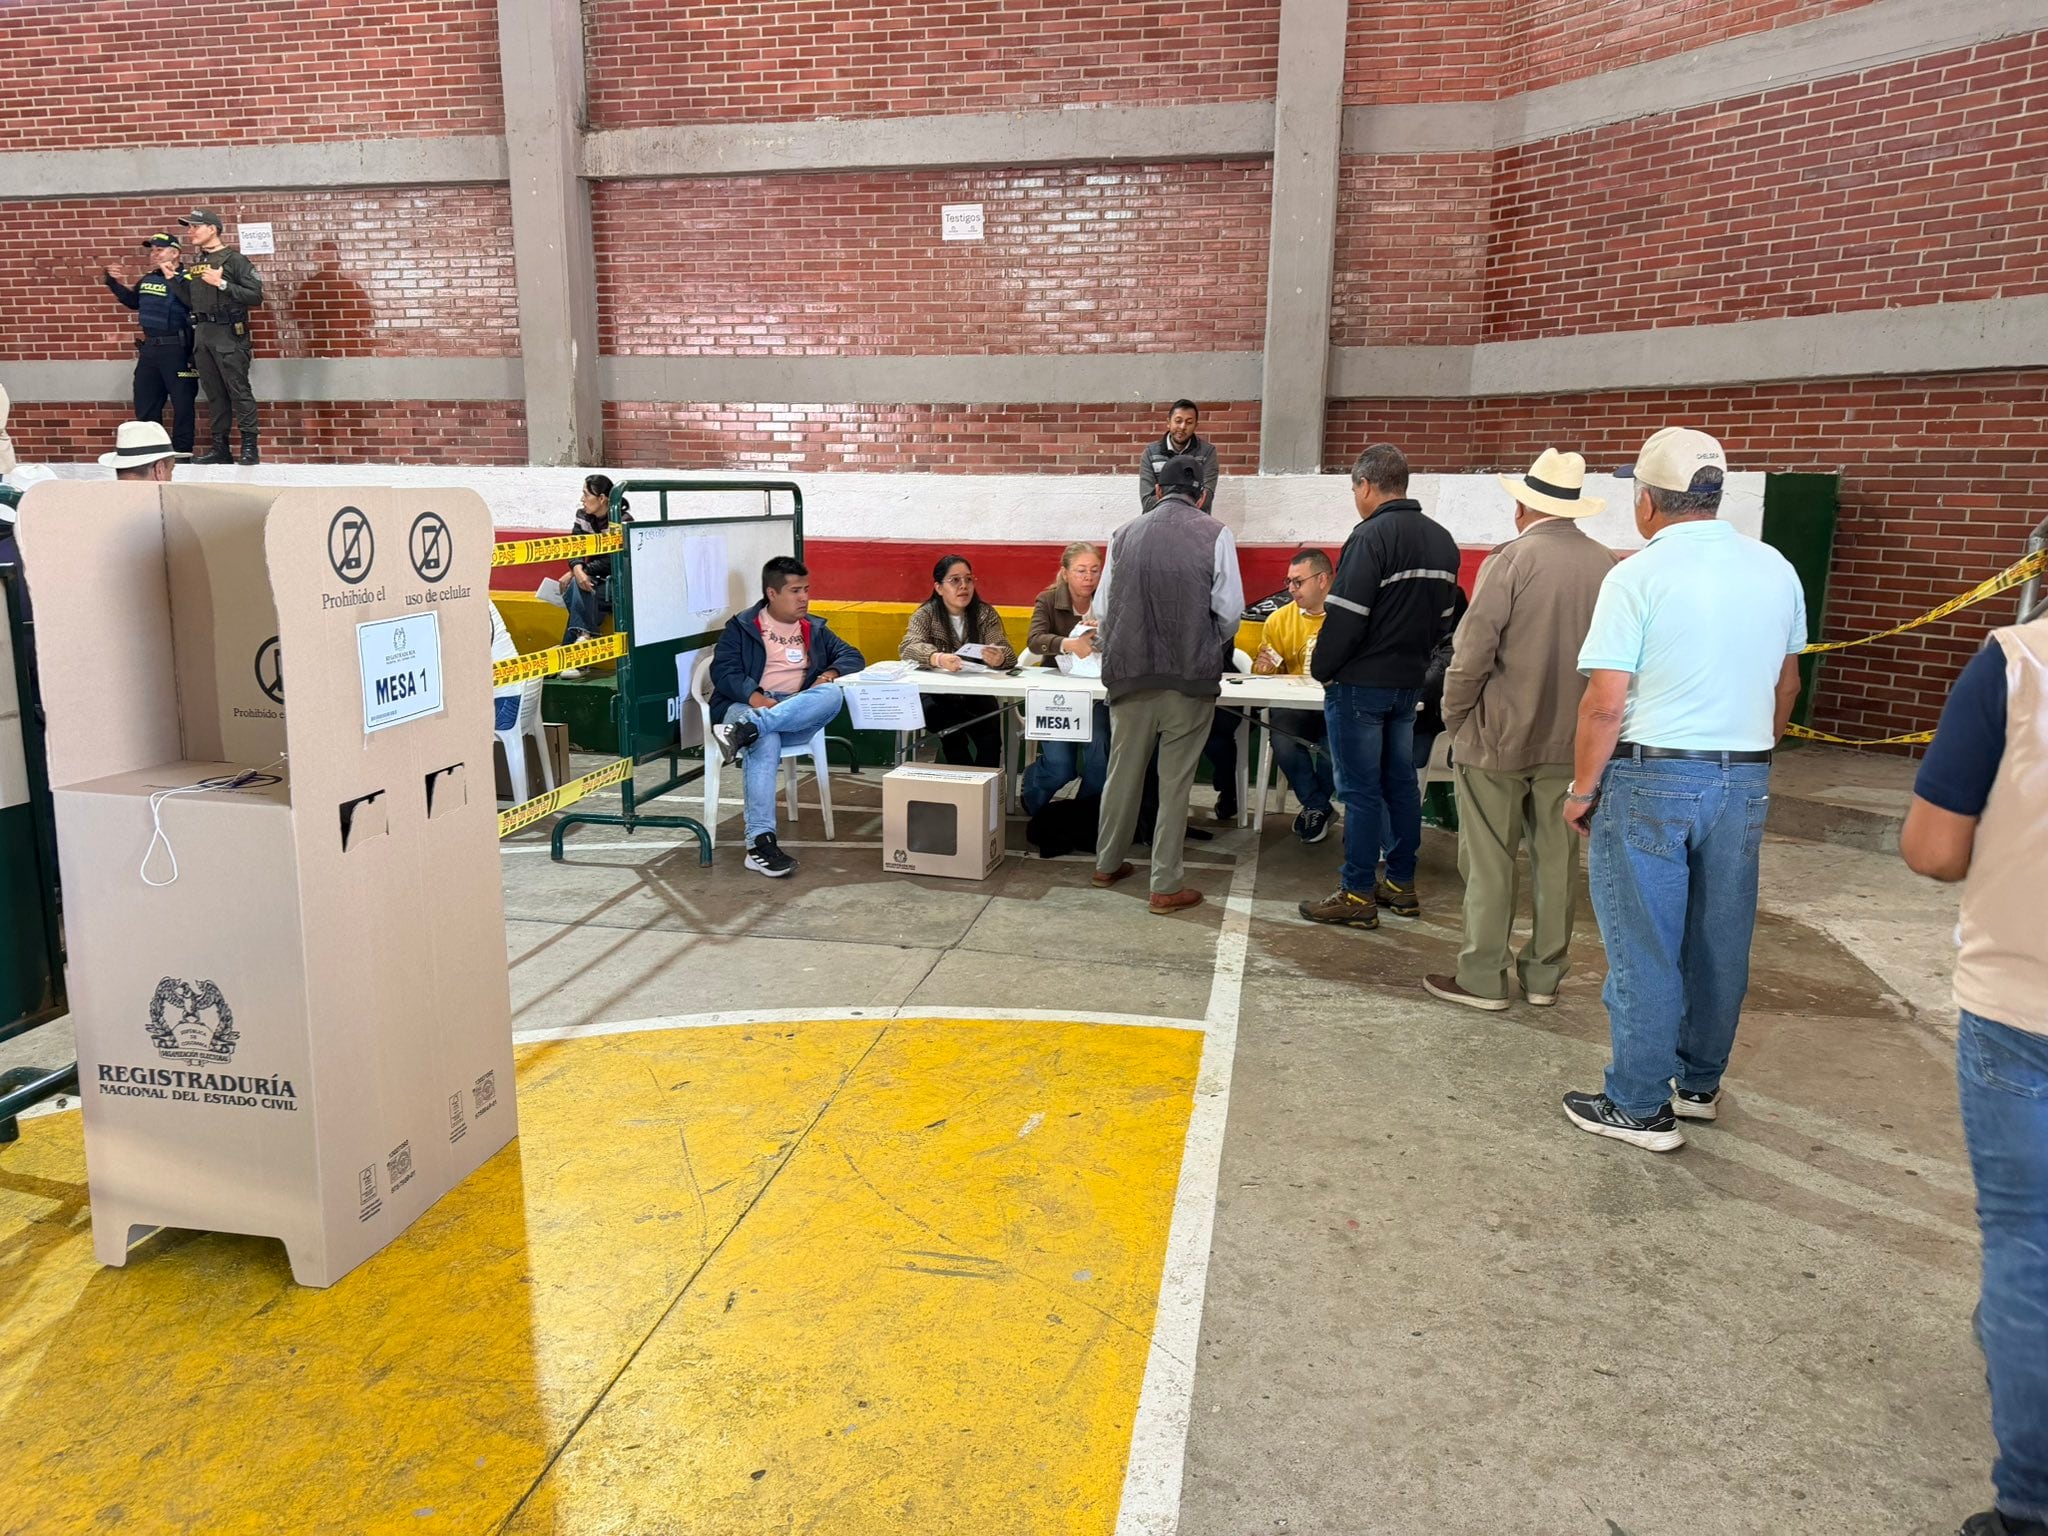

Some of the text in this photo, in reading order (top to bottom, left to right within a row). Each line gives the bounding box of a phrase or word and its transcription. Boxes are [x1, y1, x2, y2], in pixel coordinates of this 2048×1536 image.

[945, 213, 981, 224] Testigos
[499, 549, 516, 561] PASE
[534, 545, 560, 557] PELIGRO
[562, 543, 571, 552] NO
[572, 540, 587, 551] PASE
[321, 585, 386, 610] Prohibido el
[405, 584, 471, 606] uso de celular
[522, 662, 532, 673] NO
[532, 658, 549, 669] PASE
[591, 646, 600, 656] NO
[375, 667, 427, 705] MESA 1
[233, 707, 278, 719] Prohibido
[1036, 715, 1080, 730] MESA 1
[97, 1063, 297, 1098] REGISTRADURÍA
[99, 1083, 298, 1112] NACIONAL DEL ESTADO CIVIL
